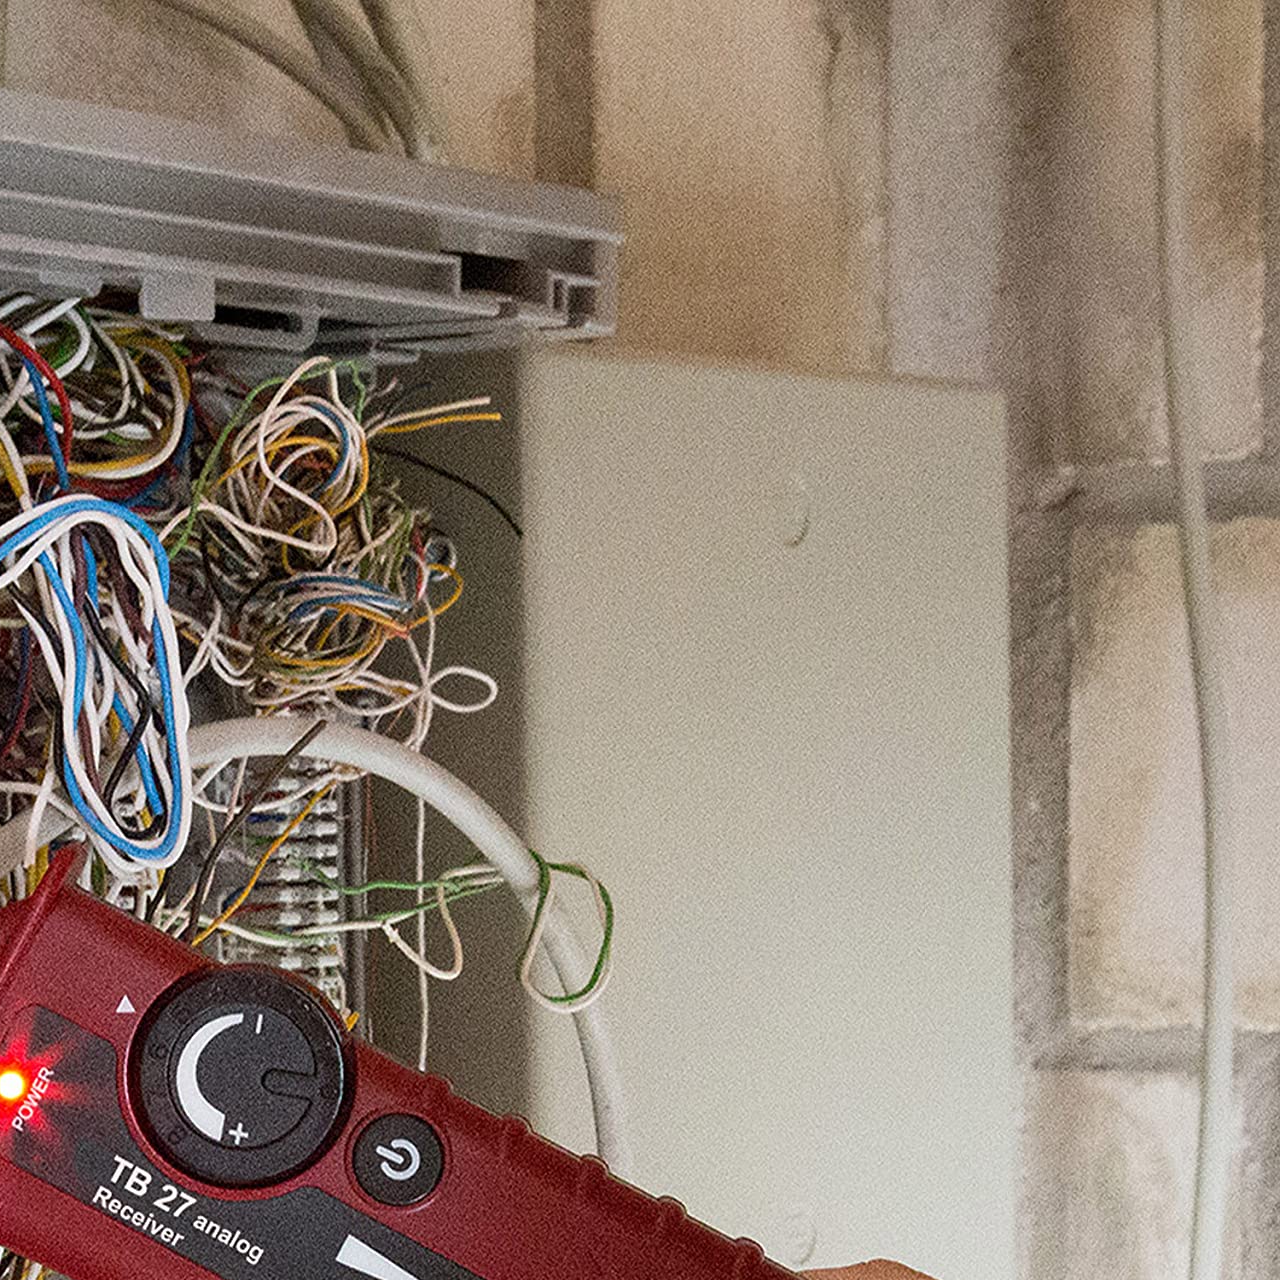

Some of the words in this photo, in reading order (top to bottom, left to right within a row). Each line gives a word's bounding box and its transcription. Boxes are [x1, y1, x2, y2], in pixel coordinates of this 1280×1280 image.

[11, 1066, 55, 1132] POWER
[92, 1185, 185, 1247] Receiver
[110, 1154, 152, 1197] TB
[152, 1184, 197, 1218] 27
[193, 1215, 265, 1266] analog
